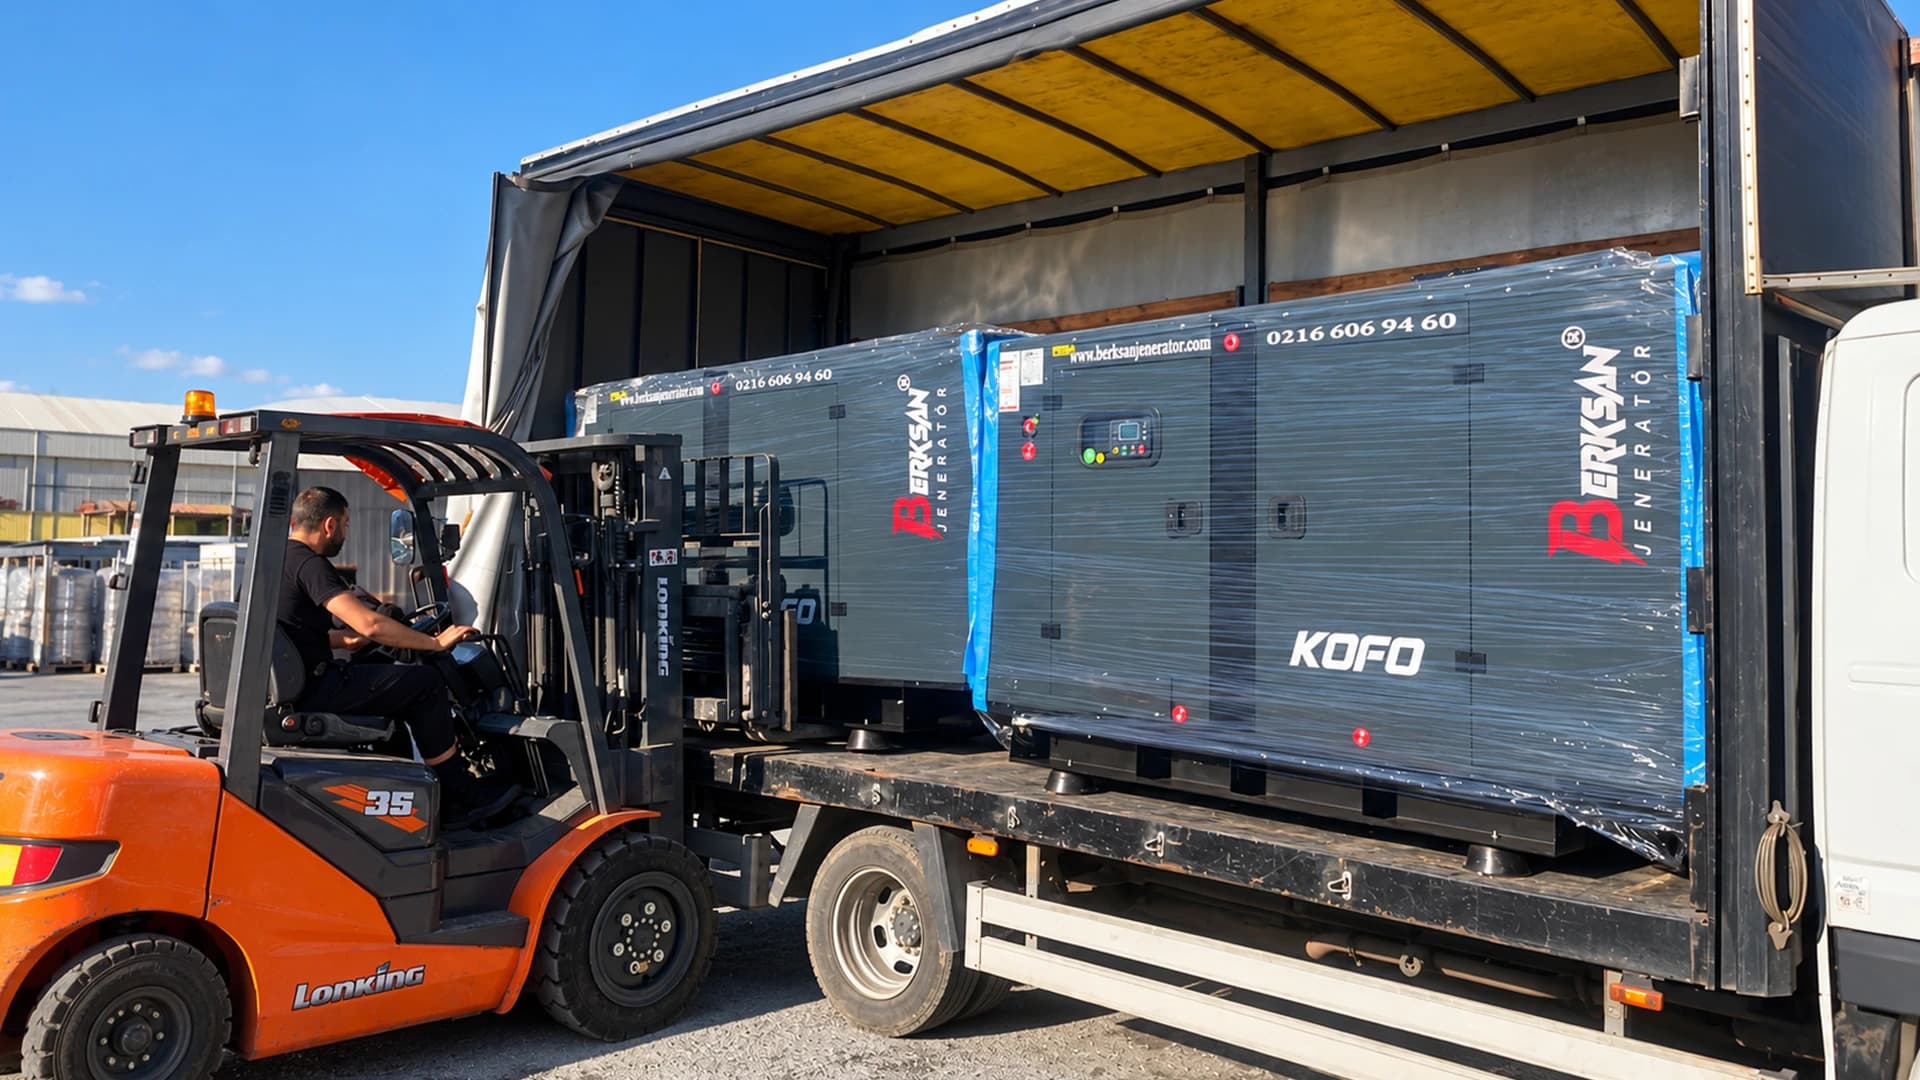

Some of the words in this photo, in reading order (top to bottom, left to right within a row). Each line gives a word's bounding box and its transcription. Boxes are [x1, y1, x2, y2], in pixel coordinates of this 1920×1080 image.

[1265, 325, 1325, 345] 0216
[1330, 320, 1375, 339] 606
[1381, 316, 1415, 335] 94
[1420, 312, 1457, 331] 60
[1069, 337, 1212, 364] www.berksanjenerator.com
[735, 375, 766, 391] 0216
[768, 373, 792, 387] 606
[794, 370, 812, 384] 94
[814, 368, 833, 381] 60
[892, 387, 944, 540] BERKSAN
[934, 387, 948, 533] JENERATÖR
[1547, 344, 1648, 565] BERKSAN
[1630, 345, 1652, 556] JENERATÖR
[780, 598, 817, 625] FO
[1288, 630, 1426, 677] KOFO
[364, 790, 415, 816] 35
